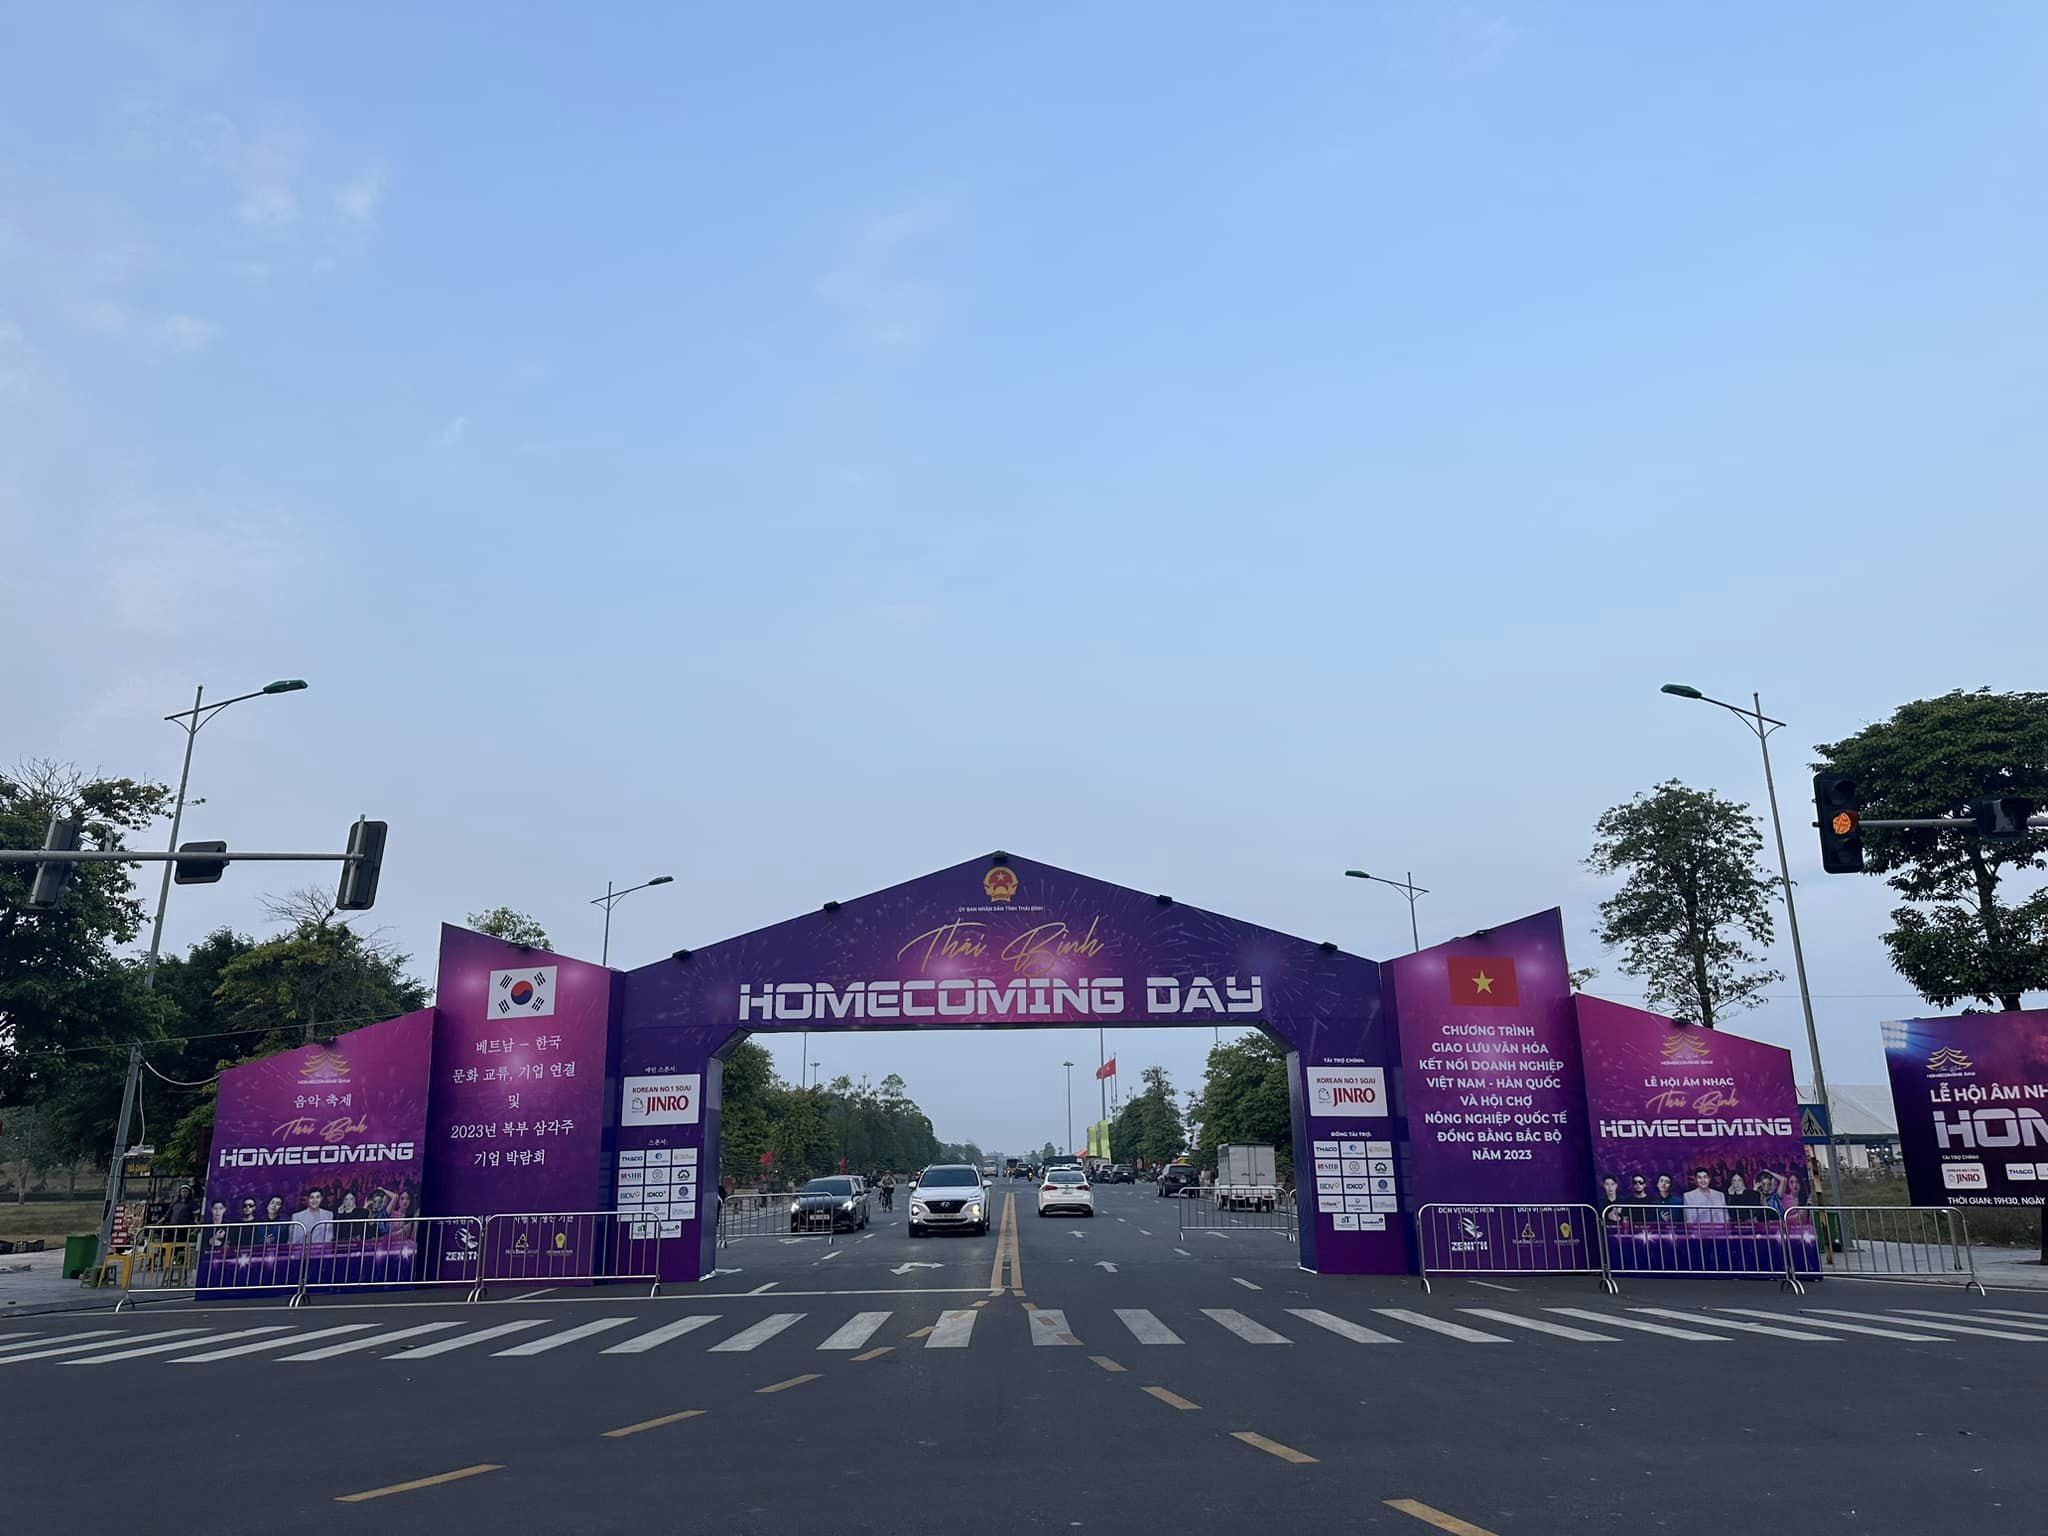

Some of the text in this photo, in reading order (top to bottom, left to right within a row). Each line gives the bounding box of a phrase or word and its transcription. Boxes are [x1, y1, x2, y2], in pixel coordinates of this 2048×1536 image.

[738, 975, 1263, 1020] HOMECOMING DAY
[1442, 1024, 1535, 1036] CHƯƠNG TRÌNH
[476, 1038, 515, 1054] 베트남
[536, 1035, 562, 1051] 한국
[1432, 1040, 1549, 1054] GIAO LƯU VĂN HÓA
[1419, 1056, 1564, 1073] KẾT NỐI DOANH NGHIỆP
[452, 1068, 479, 1084] 문화
[518, 1064, 544, 1079] 기업
[550, 1062, 576, 1078] 연결
[1426, 1075, 1454, 1090] VIỆT
[1457, 1078, 1486, 1088] NAM
[1496, 1076, 1523, 1088] HÀN
[1526, 1074, 1560, 1090] QUỐC
[1644, 1076, 1734, 1088] LỄ HỘI ÂM NHẠC
[294, 1093, 352, 1109] 음악 축제
[508, 1093, 520, 1109] 및
[1333, 1088, 1376, 1107] JINRO
[1930, 1082, 1951, 1102] LỄ
[1954, 1084, 1987, 1104] HỘI
[1991, 1083, 2020, 1100] ÂM
[645, 1095, 689, 1116] JINRO
[1460, 1094, 1532, 1109] VÀ HỘI CHỢ
[1425, 1110, 1567, 1126] NÔNG NGHIỆP QUỐC TẾ
[450, 1122, 497, 1139] 2023년
[533, 1120, 575, 1136] 삼각주
[1600, 1118, 1792, 1137] HOMECOMING
[1544, 1128, 1562, 1144] BỘ
[219, 1142, 414, 1168] HOMECOMING
[474, 1148, 546, 1167] 기업 박람회
[1472, 1148, 1532, 1160] NĂM 2023
[1956, 1174, 1980, 1184] JINRO
[1948, 1196, 1967, 1204] THỜI
[2021, 1196, 2046, 1205] NGÀY
